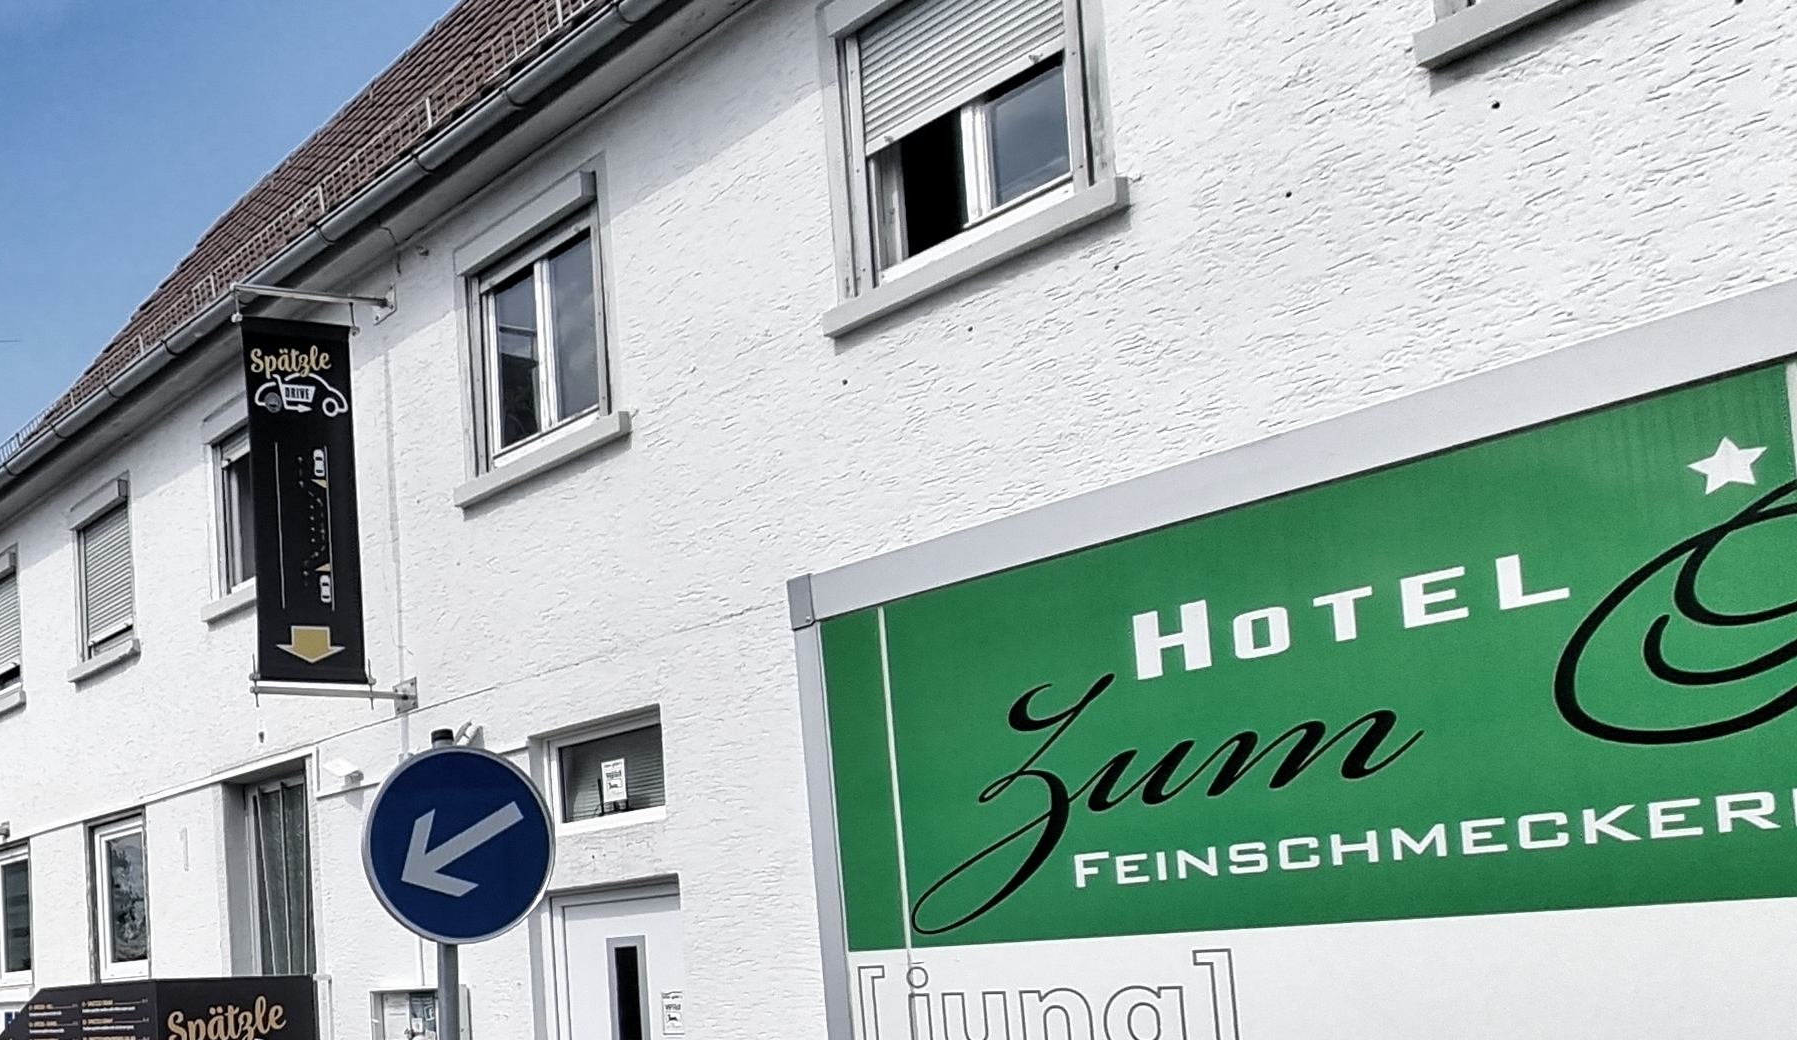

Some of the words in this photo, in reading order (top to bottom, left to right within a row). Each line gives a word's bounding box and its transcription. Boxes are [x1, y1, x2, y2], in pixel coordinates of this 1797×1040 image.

[250, 345, 332, 379] Spätzle
[911, 672, 1425, 935] Zum
[1074, 788, 1797, 888] FEINSCHMECKER
